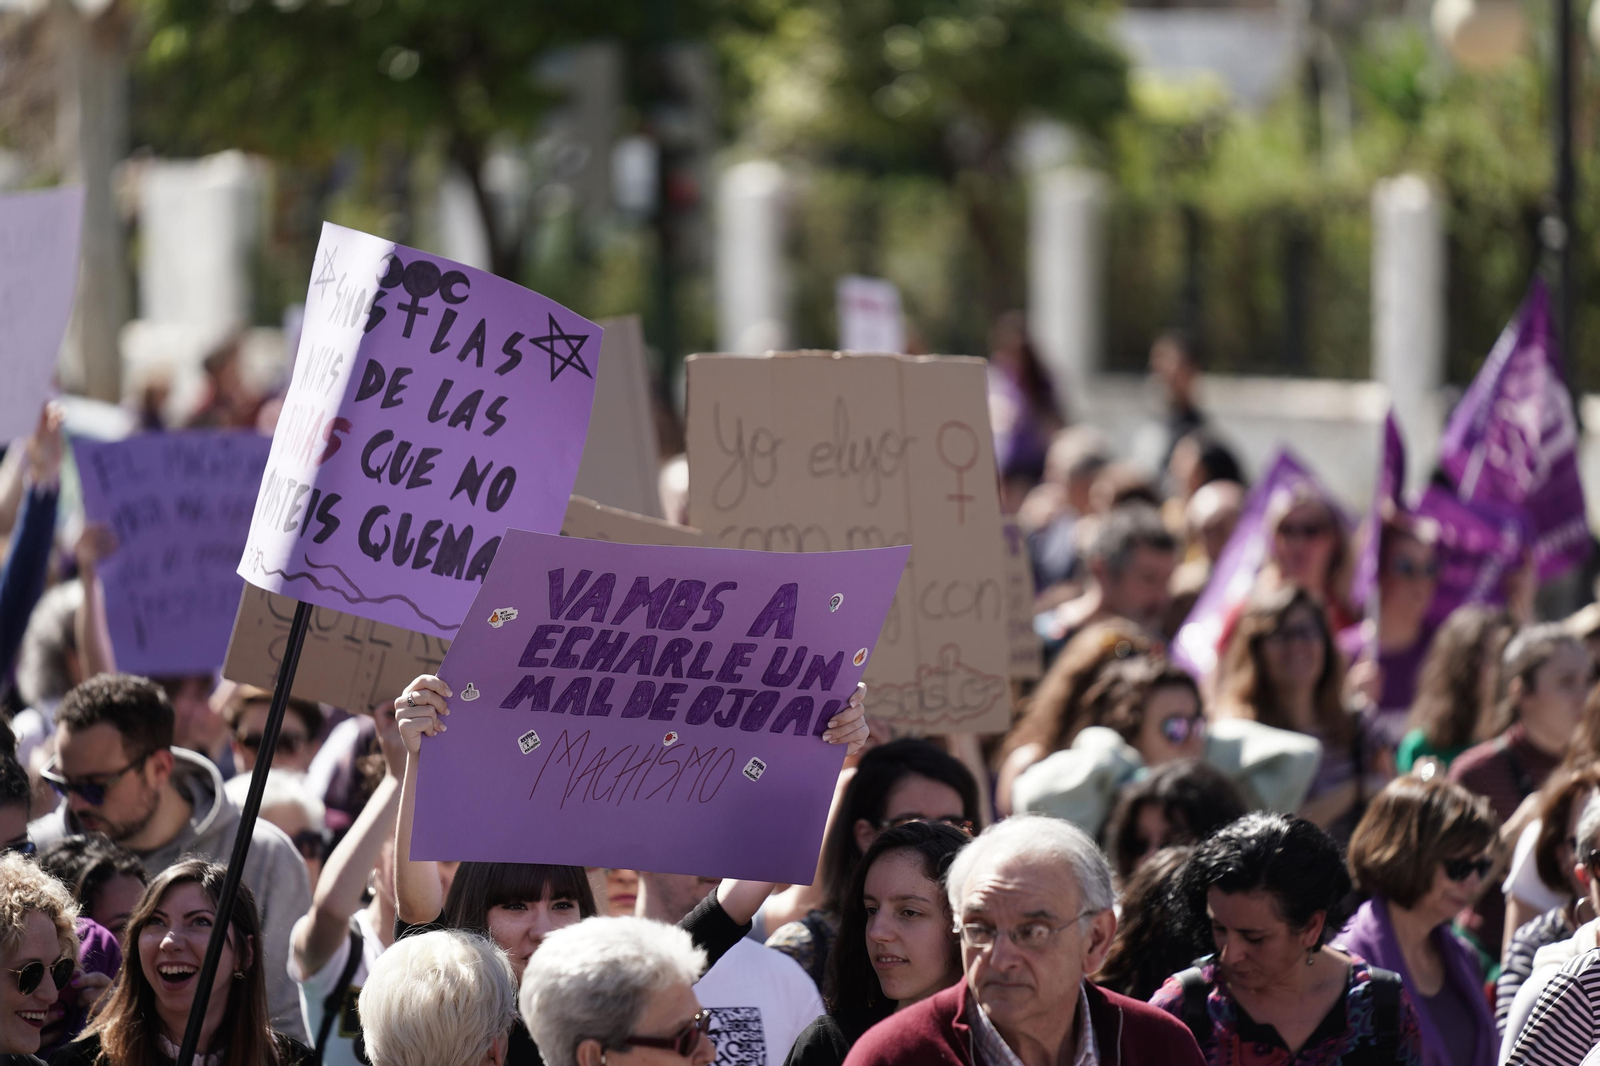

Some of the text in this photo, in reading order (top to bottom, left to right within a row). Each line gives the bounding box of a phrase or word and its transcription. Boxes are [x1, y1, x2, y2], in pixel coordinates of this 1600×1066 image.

[430, 308, 526, 376] LAS
[354, 358, 413, 409] DE
[427, 378, 509, 437] LAS
[361, 429, 443, 490] QUE
[449, 455, 517, 513] NO
[548, 568, 798, 640] VAMOS A
[918, 578, 1002, 622] con
[518, 624, 845, 692] ECHARLE UN
[499, 675, 615, 718] MAL
[621, 680, 688, 722] DE
[529, 729, 735, 810] MACHISMO
